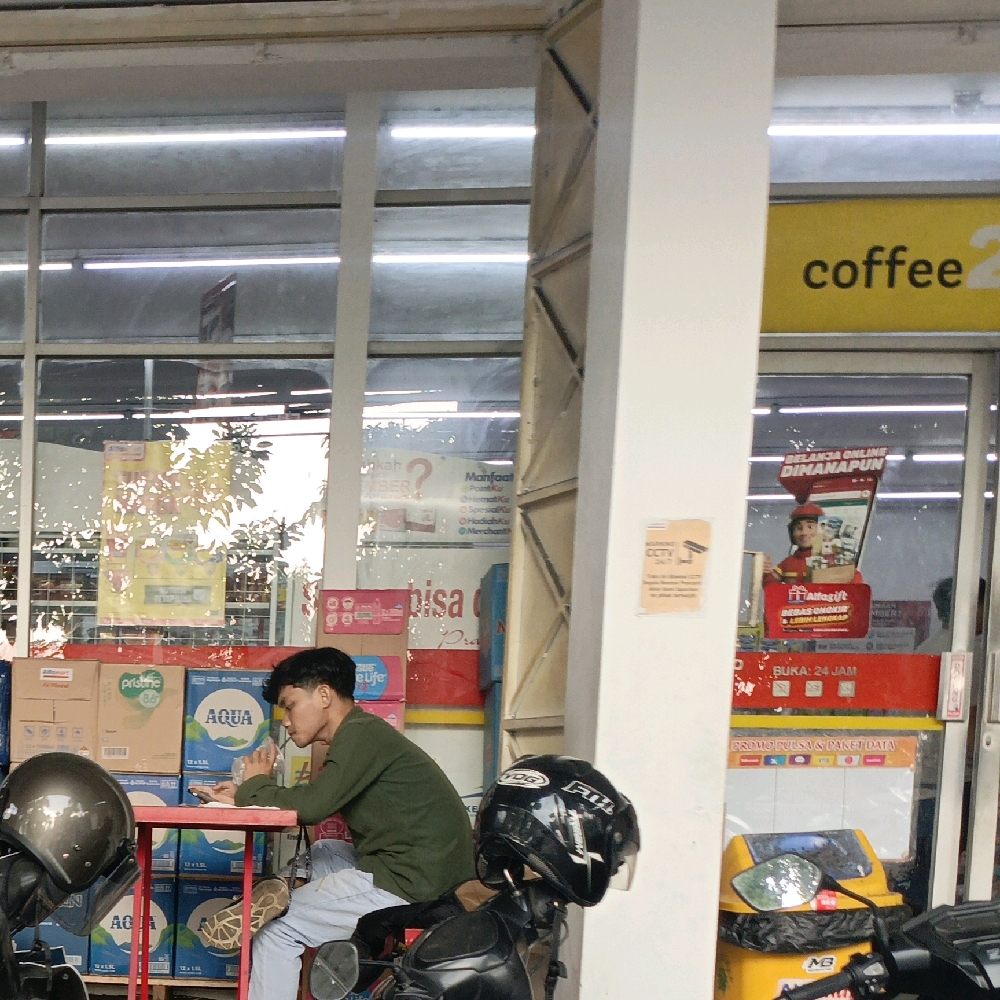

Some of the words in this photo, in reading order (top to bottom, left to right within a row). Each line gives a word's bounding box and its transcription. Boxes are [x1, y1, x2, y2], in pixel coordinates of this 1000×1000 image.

[803, 245, 963, 289] coffee
[843, 447, 888, 460] ONLINE
[780, 458, 885, 478] DIMANAPUN
[807, 590, 848, 603] Alfagift
[814, 666, 829, 676] 24
[832, 666, 857, 677] JAM
[205, 708, 253, 727] AQUA
[732, 740, 774, 751] PROMO
[775, 740, 812, 751] PULSA
[827, 740, 865, 751] PAKET
[866, 740, 896, 751] DATA
